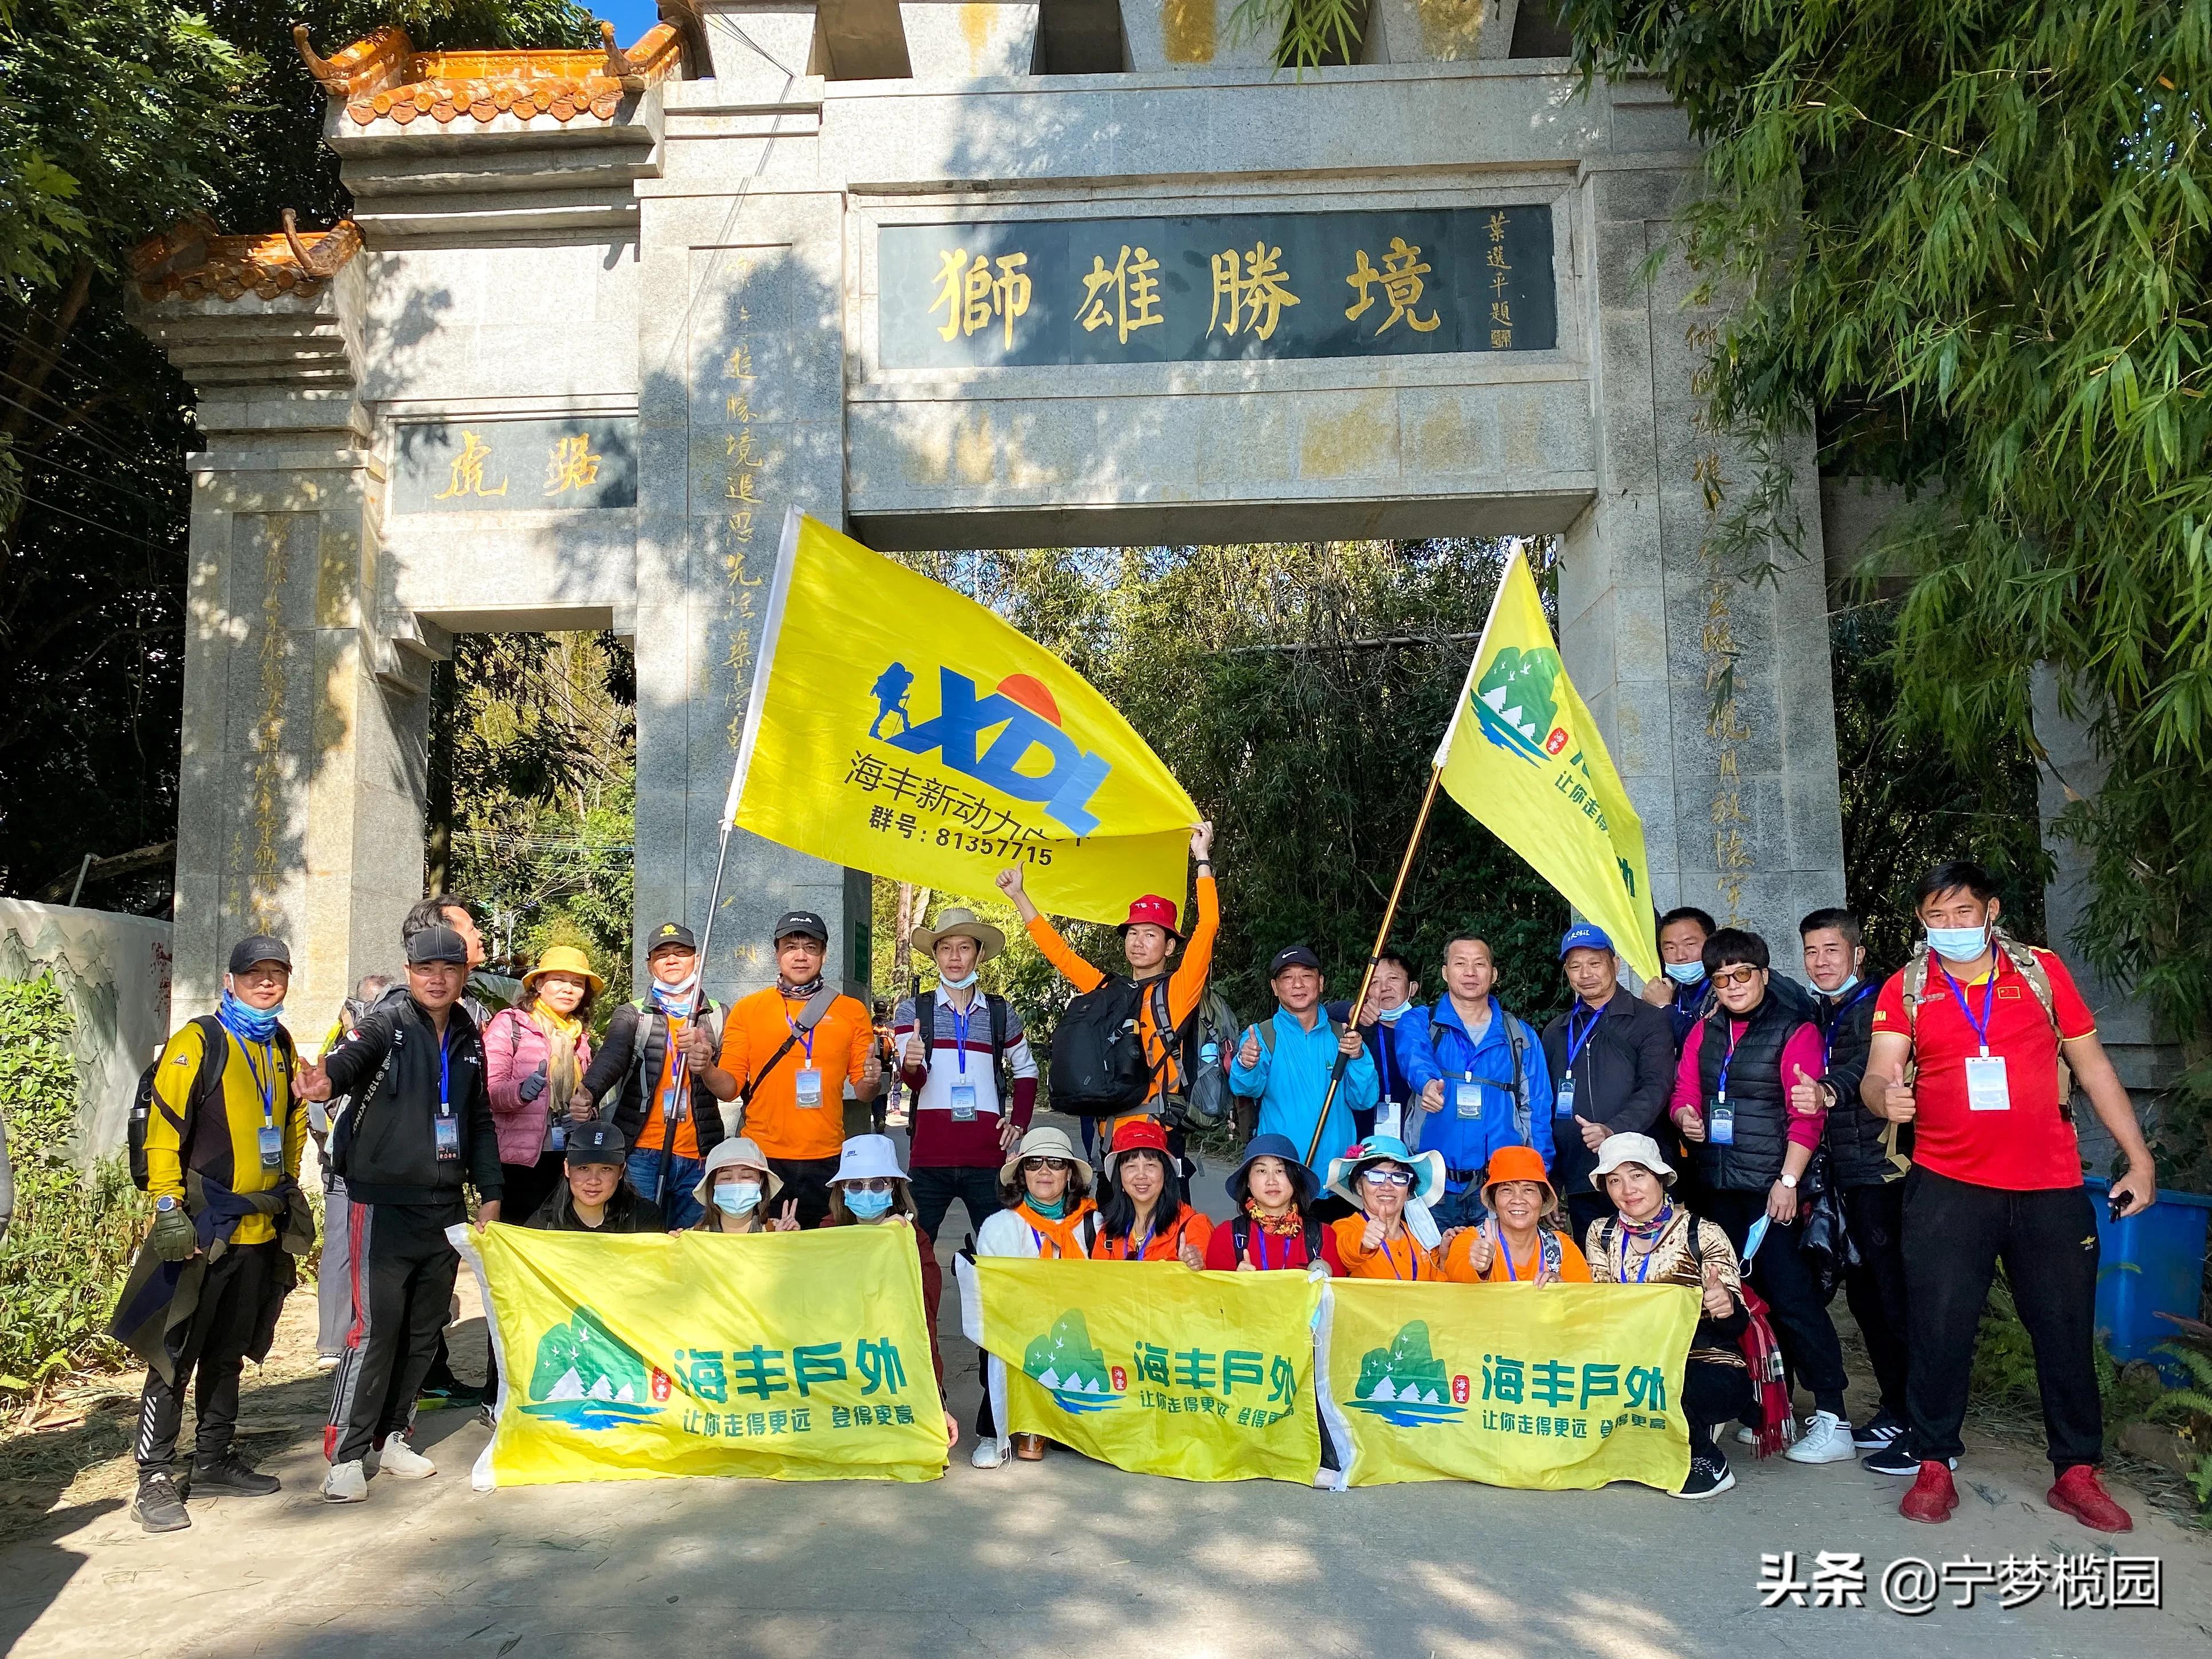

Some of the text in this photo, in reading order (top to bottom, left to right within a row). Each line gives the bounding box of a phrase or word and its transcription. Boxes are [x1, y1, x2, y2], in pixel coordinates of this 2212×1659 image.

[928, 237, 1440, 350] 獅雄勝境
[884, 665, 1112, 837] XDL
[684, 1407, 811, 1437] 让你走得更远
[1482, 1410, 1587, 1438] 让你走得更远
